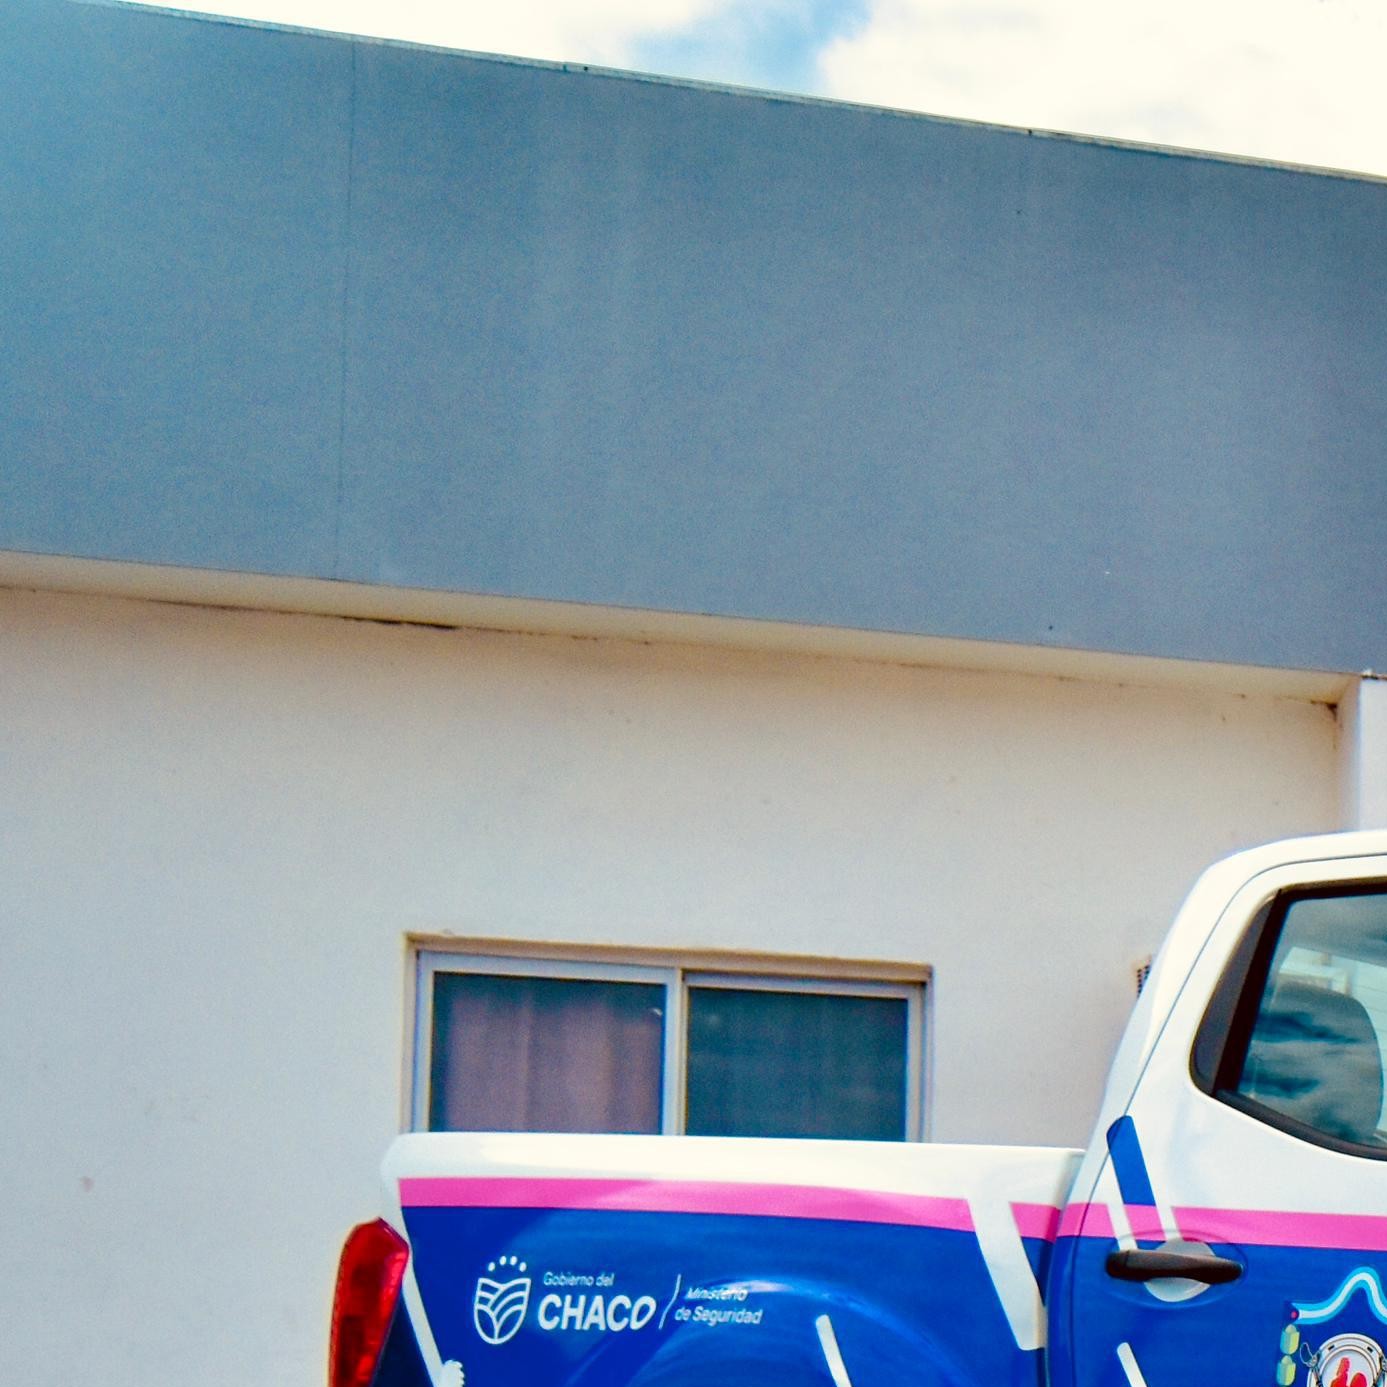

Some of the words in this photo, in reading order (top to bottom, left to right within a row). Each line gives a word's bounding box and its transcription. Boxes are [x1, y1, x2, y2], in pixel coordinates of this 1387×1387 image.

[543, 1271, 595, 1287] Gobierno
[595, 1272, 615, 1287] del
[538, 1293, 657, 1332] CHACO
[674, 1307, 692, 1322] de
[692, 1305, 763, 1327] Seguridad
